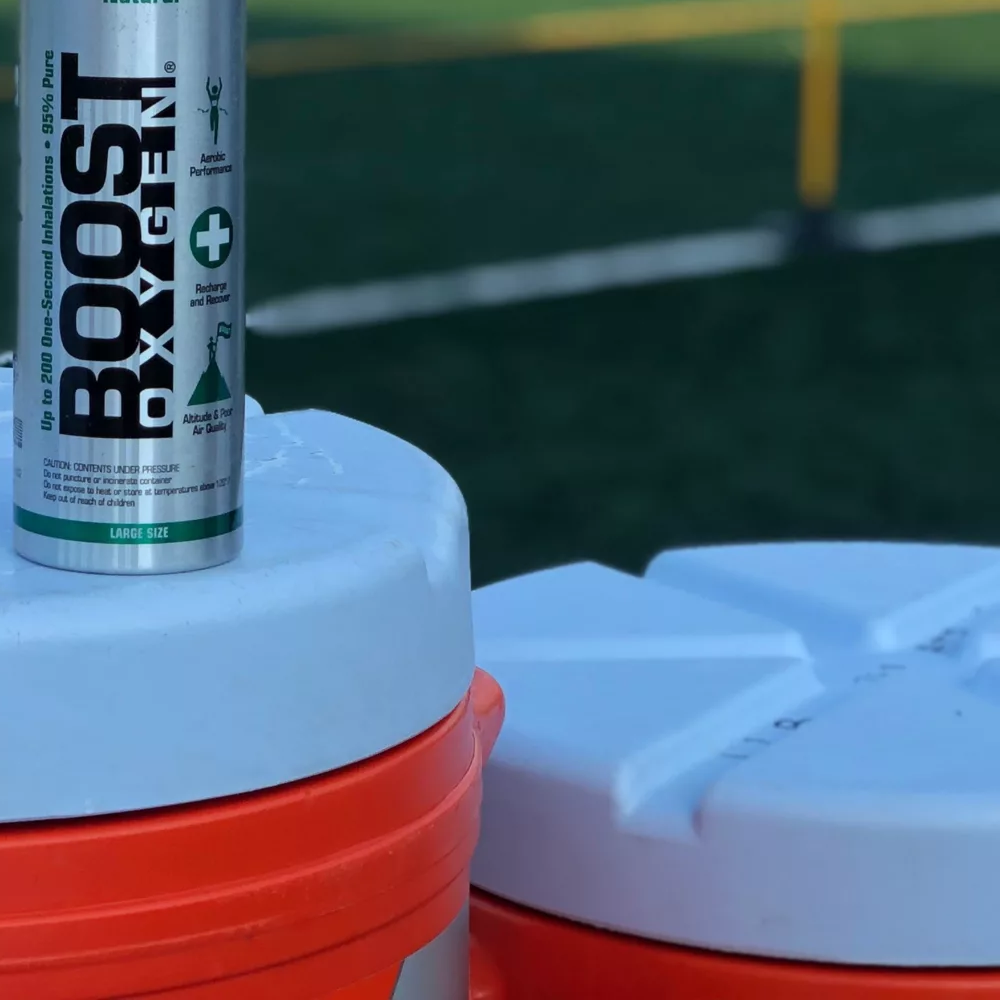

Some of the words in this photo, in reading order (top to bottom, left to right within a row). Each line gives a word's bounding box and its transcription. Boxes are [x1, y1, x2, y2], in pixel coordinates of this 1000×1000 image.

[42, 50, 54, 88] Pure
[42, 94, 54, 134] 95%
[200, 151, 226, 164] Aerobic
[42, 155, 54, 245] Inhalations
[59, 52, 142, 438] BOOST
[195, 282, 227, 294] Recharge
[41, 250, 53, 347] One-Second
[190, 296, 204, 307] and
[41, 352, 53, 384] 200
[42, 392, 53, 405] to
[41, 411, 55, 431] Up
[193, 425, 204, 435] Air
[73, 462, 112, 474] CONTENTS
[113, 465, 140, 474] UNDER
[142, 464, 180, 474] PRESSURE
[43, 469, 51, 478] Do
[52, 472, 61, 480] not
[63, 474, 91, 483] puncture
[140, 477, 172, 485] container
[43, 480, 51, 489] Do
[52, 483, 61, 491] not
[63, 485, 85, 494] expose
[87, 486, 95, 495] to
[96, 486, 111, 496] heat
[123, 488, 142, 496] store
[154, 485, 198, 496] temperatures
[43, 491, 56, 502] Keep
[58, 495, 68, 503] out
[69, 496, 76, 504] of
[78, 497, 96, 505] reach
[98, 498, 105, 506] of
[107, 499, 135, 507] children
[110, 528, 143, 539] LARGE
[147, 527, 169, 538] SIZE
